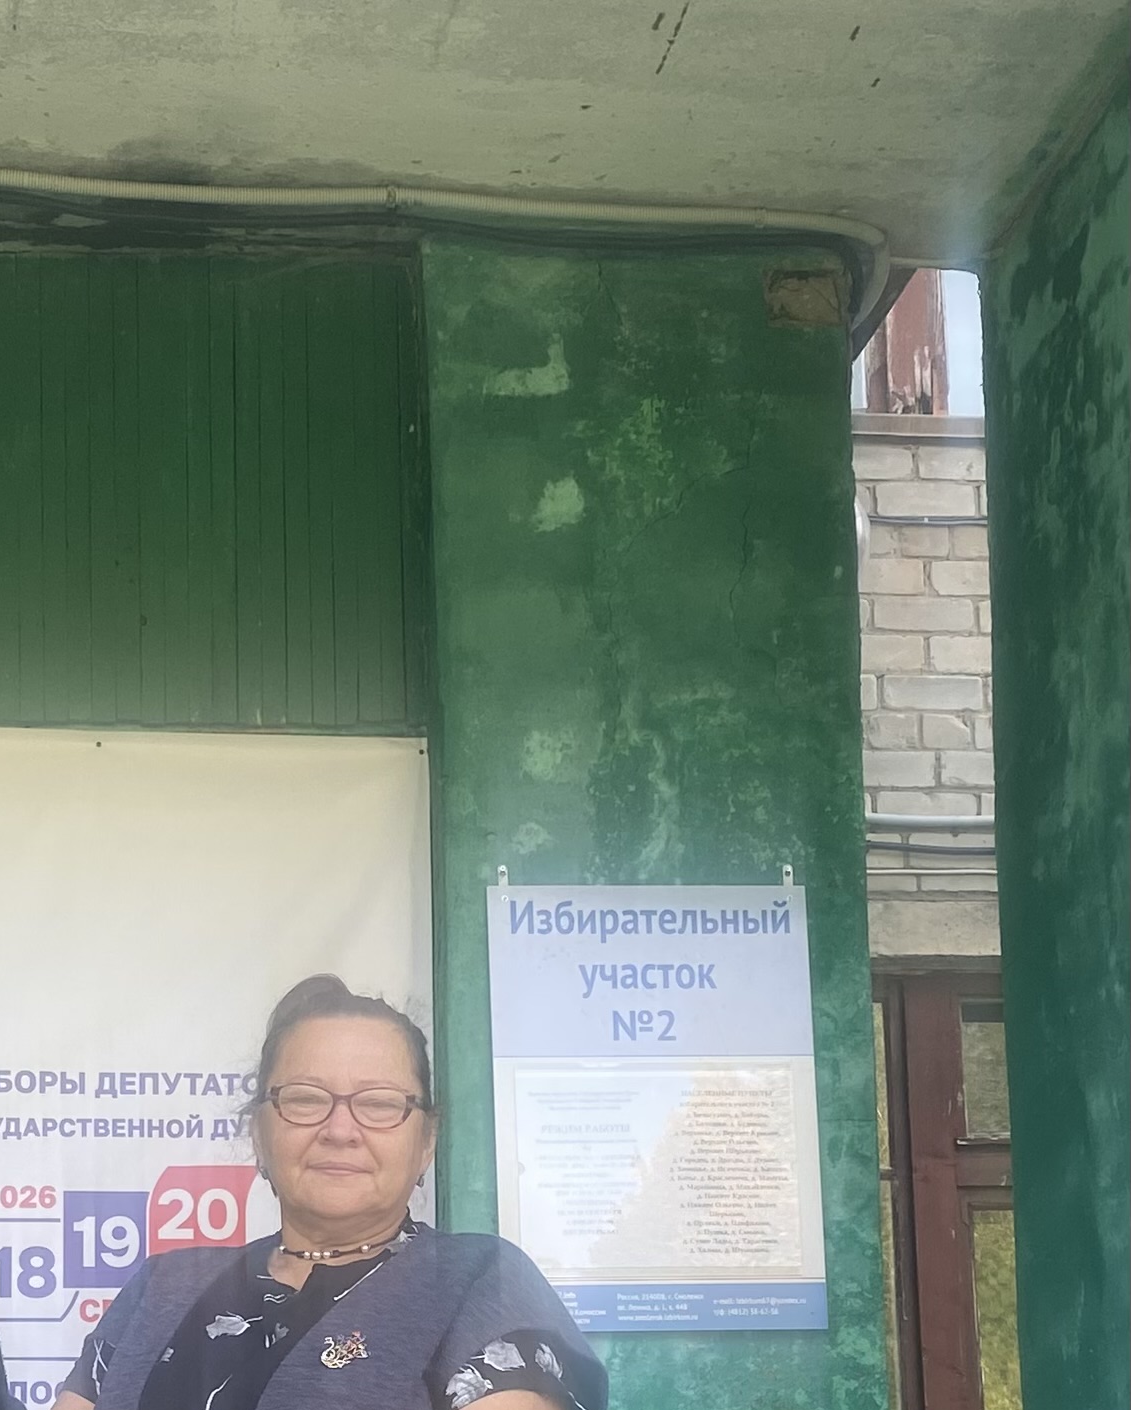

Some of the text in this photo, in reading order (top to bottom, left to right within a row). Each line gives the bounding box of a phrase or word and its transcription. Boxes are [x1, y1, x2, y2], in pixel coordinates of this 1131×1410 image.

[509, 900, 791, 943] Избирательный
[578, 962, 717, 998] участок
[612, 1009, 677, 1042] №2
[95, 1071, 259, 1098] ДЕПУТАТО
[211, 1118, 245, 1141] ДУ
[73, 1215, 140, 1268] 19
[157, 1188, 239, 1240] 20
